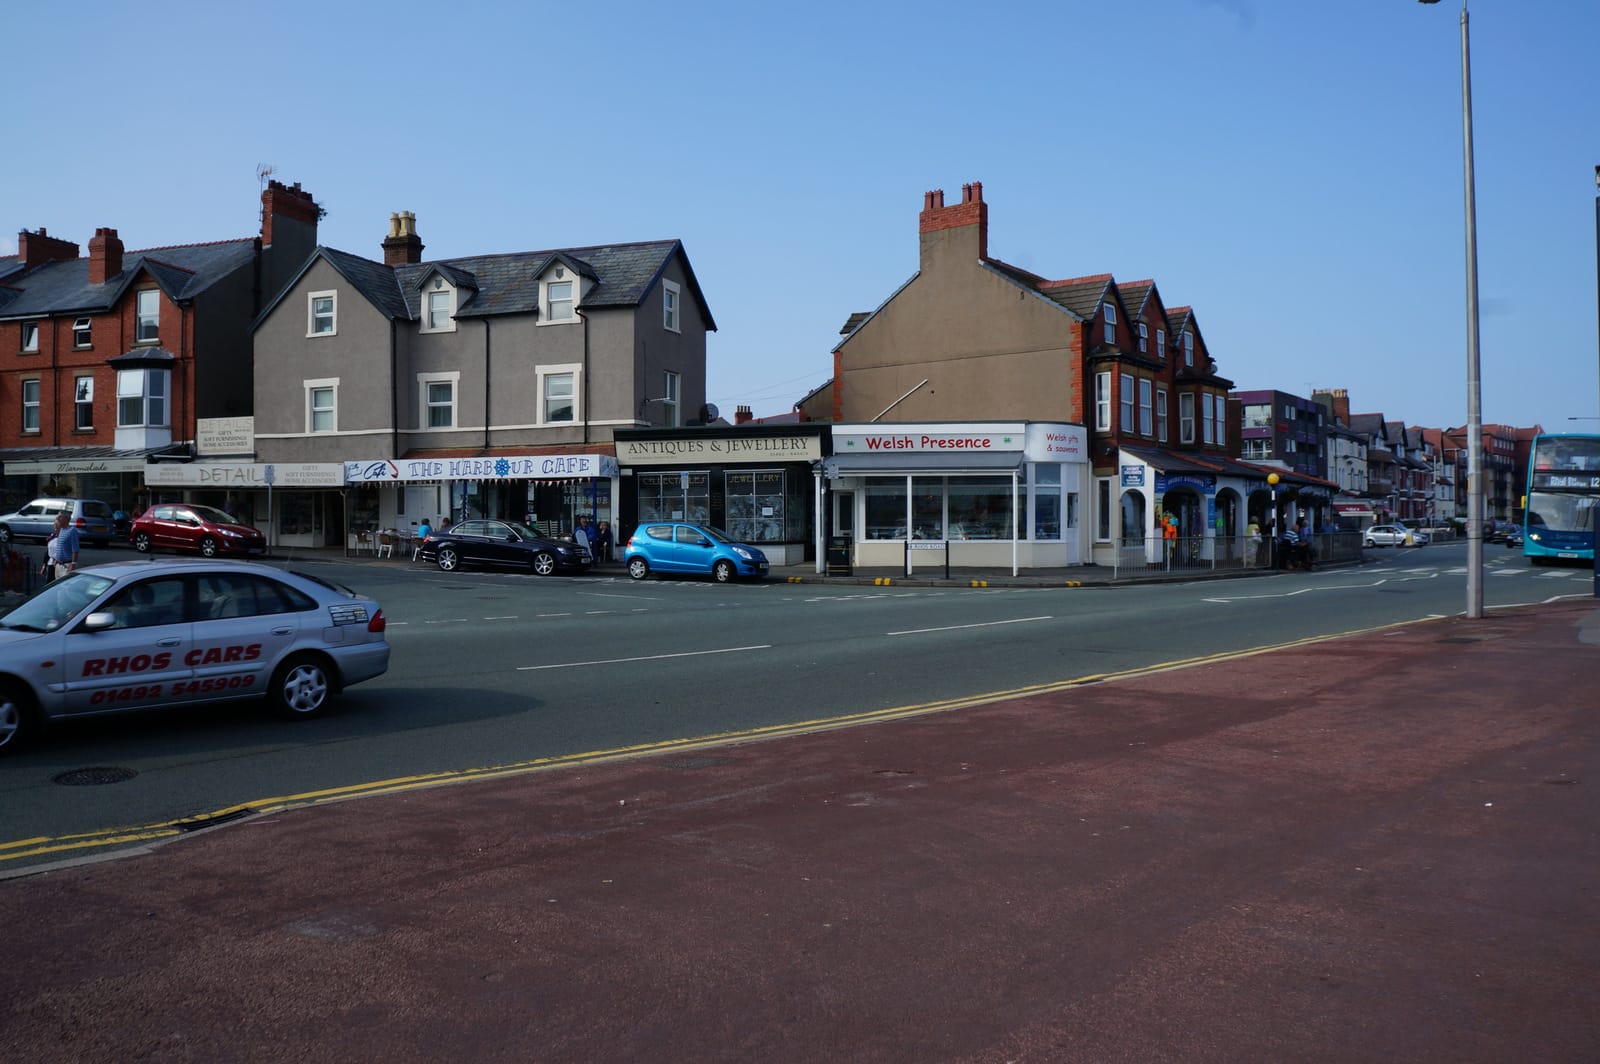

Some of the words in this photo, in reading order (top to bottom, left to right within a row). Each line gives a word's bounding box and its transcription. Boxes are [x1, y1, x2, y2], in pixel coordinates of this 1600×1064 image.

[866, 437, 914, 449] Welsh
[921, 435, 991, 449] Presence
[1046, 433, 1067, 442] Welsh
[628, 441, 704, 455] ANTIQUES
[710, 440, 722, 452] &
[726, 437, 809, 454] JEWELLERY
[1046, 443, 1053, 452] &
[199, 467, 265, 482] DETAIL
[408, 461, 442, 477] THE
[542, 457, 590, 474] CAFE
[82, 652, 173, 677] RHOS
[184, 643, 262, 667] CARS
[89, 685, 162, 705] 01492
[171, 674, 256, 696] 545909
